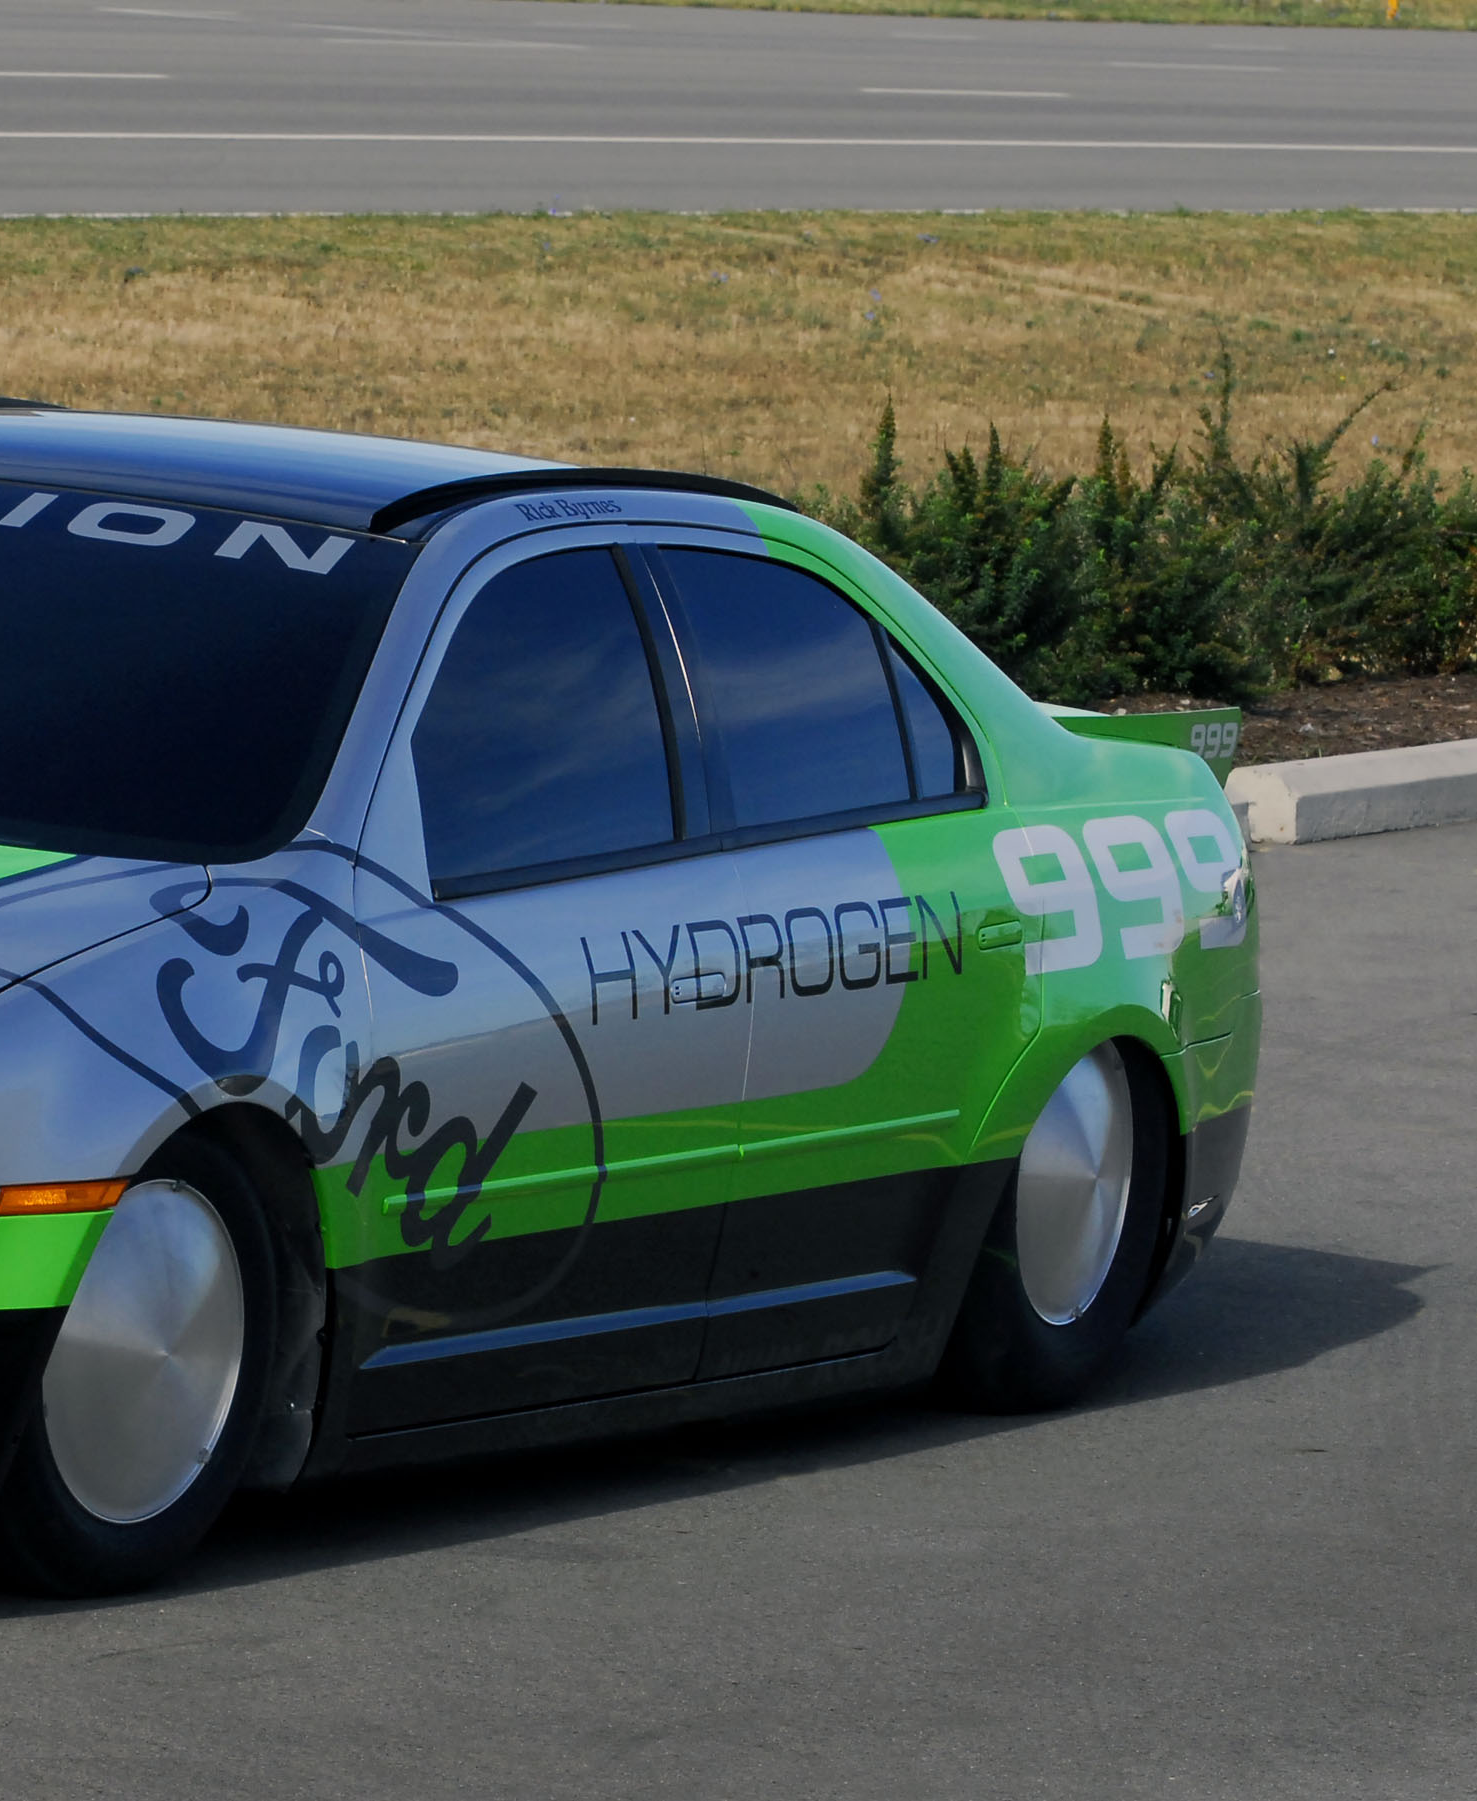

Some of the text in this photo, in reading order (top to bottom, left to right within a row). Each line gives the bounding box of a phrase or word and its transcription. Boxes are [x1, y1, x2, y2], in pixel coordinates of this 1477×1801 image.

[514, 499, 622, 521] Rick Byrnes
[1190, 722, 1238, 757] 999
[580, 891, 962, 1025] HYDROGEN
[992, 808, 1248, 976] 999
[149, 877, 538, 1271] Ford
